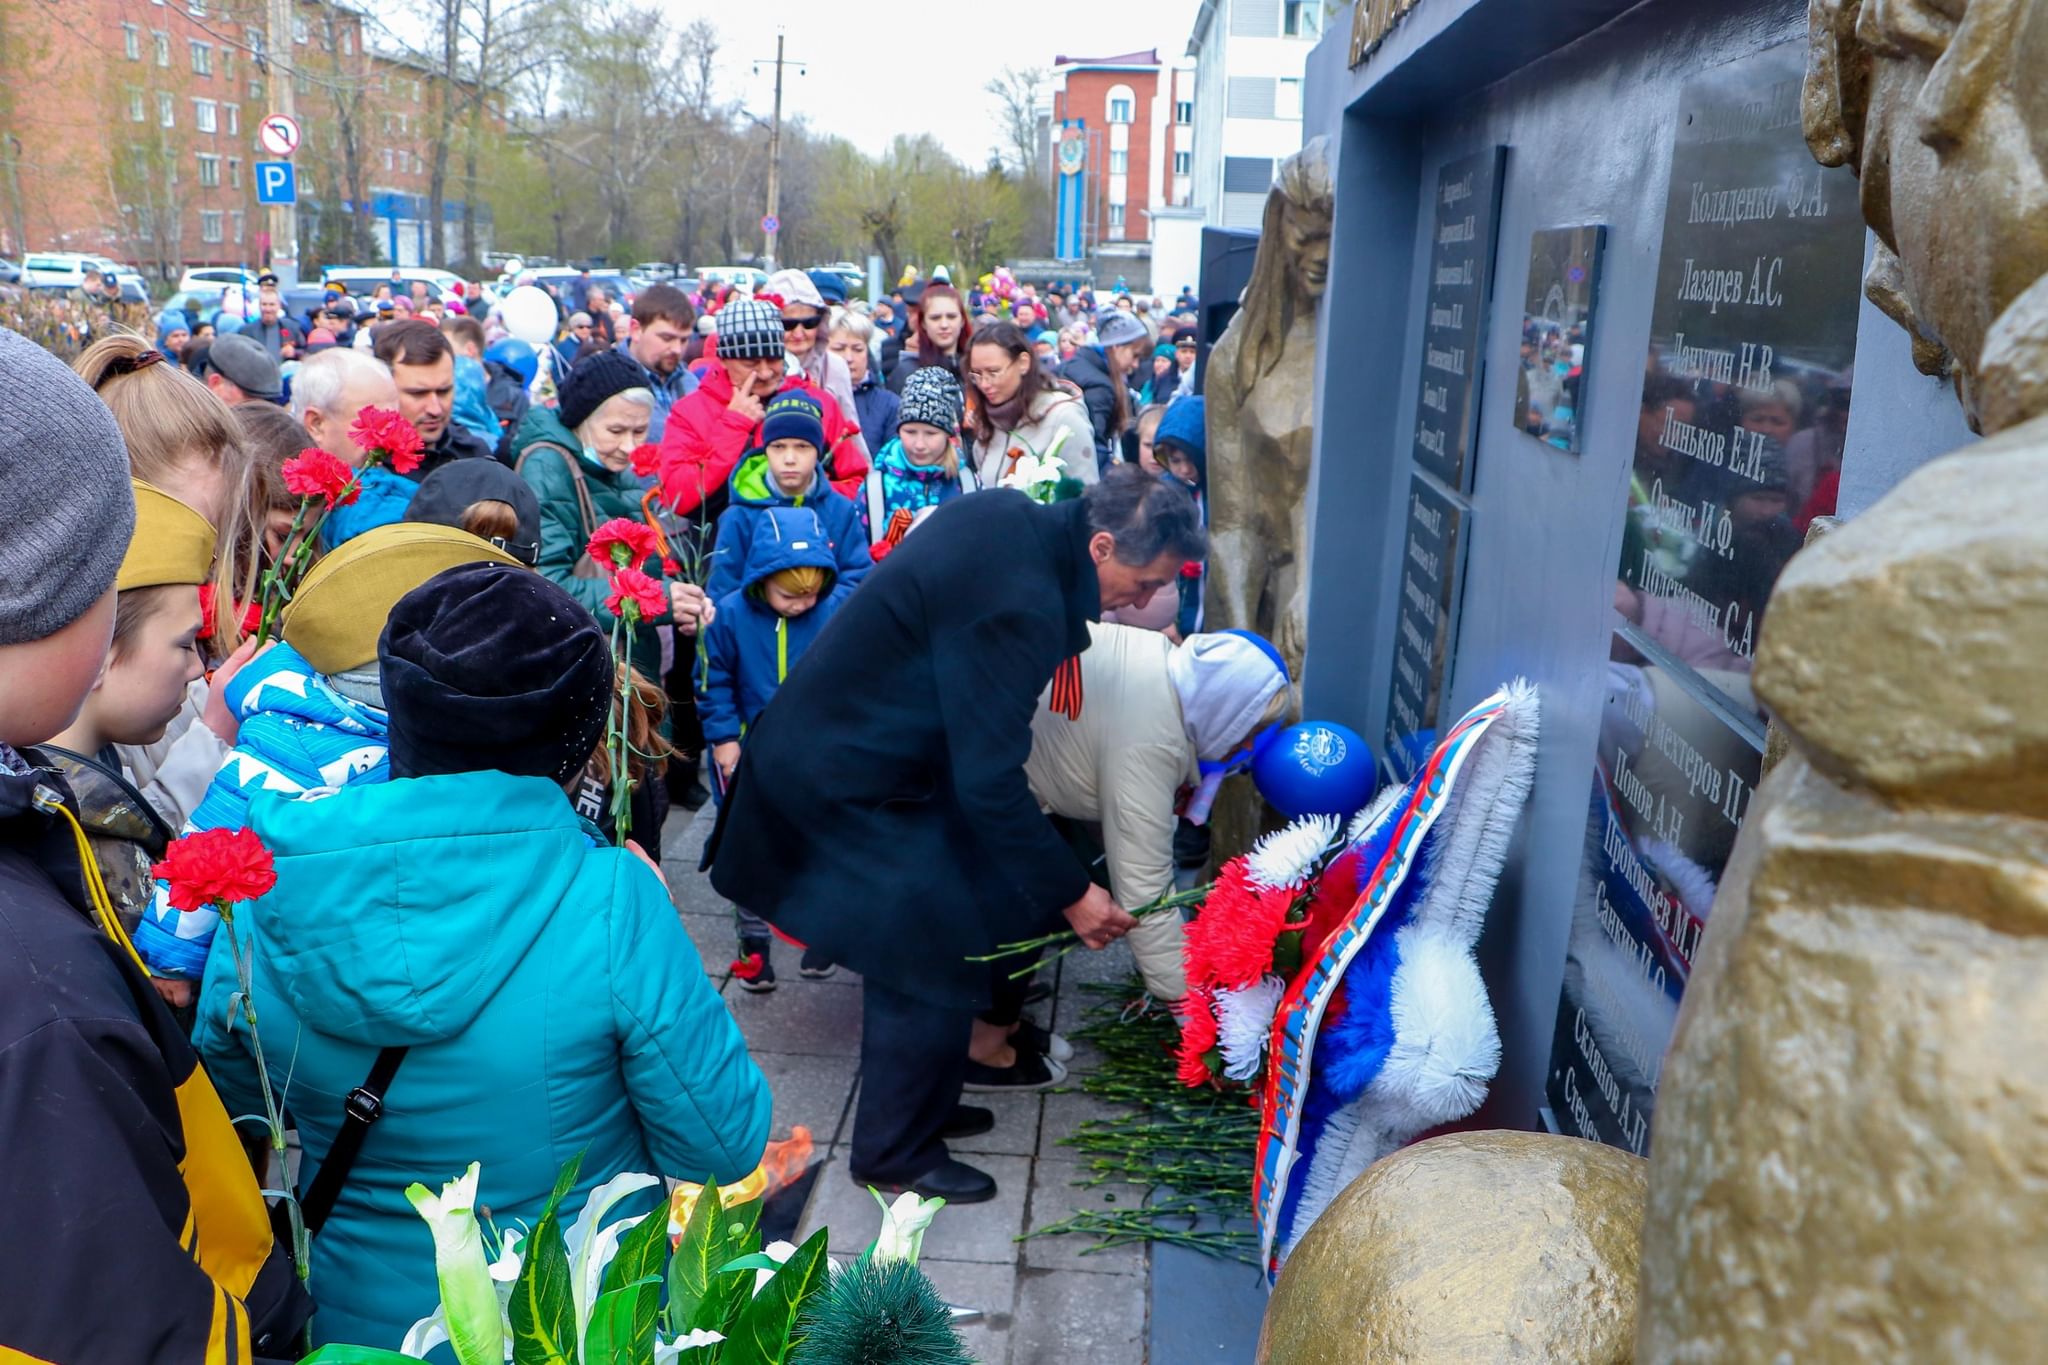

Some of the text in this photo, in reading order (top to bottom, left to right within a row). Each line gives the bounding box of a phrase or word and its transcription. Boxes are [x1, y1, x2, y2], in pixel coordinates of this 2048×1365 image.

[264, 165, 287, 198] P
[1688, 180, 1778, 231] Коляденко
[1677, 256, 1783, 314] Лазарев А.С.
[1668, 332, 1776, 394] Лачугин Н.В.
[1658, 406, 1767, 484] Линьков Е.И.
[1697, 499, 1735, 561] И.Ф.
[575, 775, 605, 820] HE
[1613, 747, 1654, 823] Попов
[1722, 768, 1756, 829] П.
[1602, 811, 1672, 931] Прокопьев
[1574, 1006, 1621, 1115] Склянов
